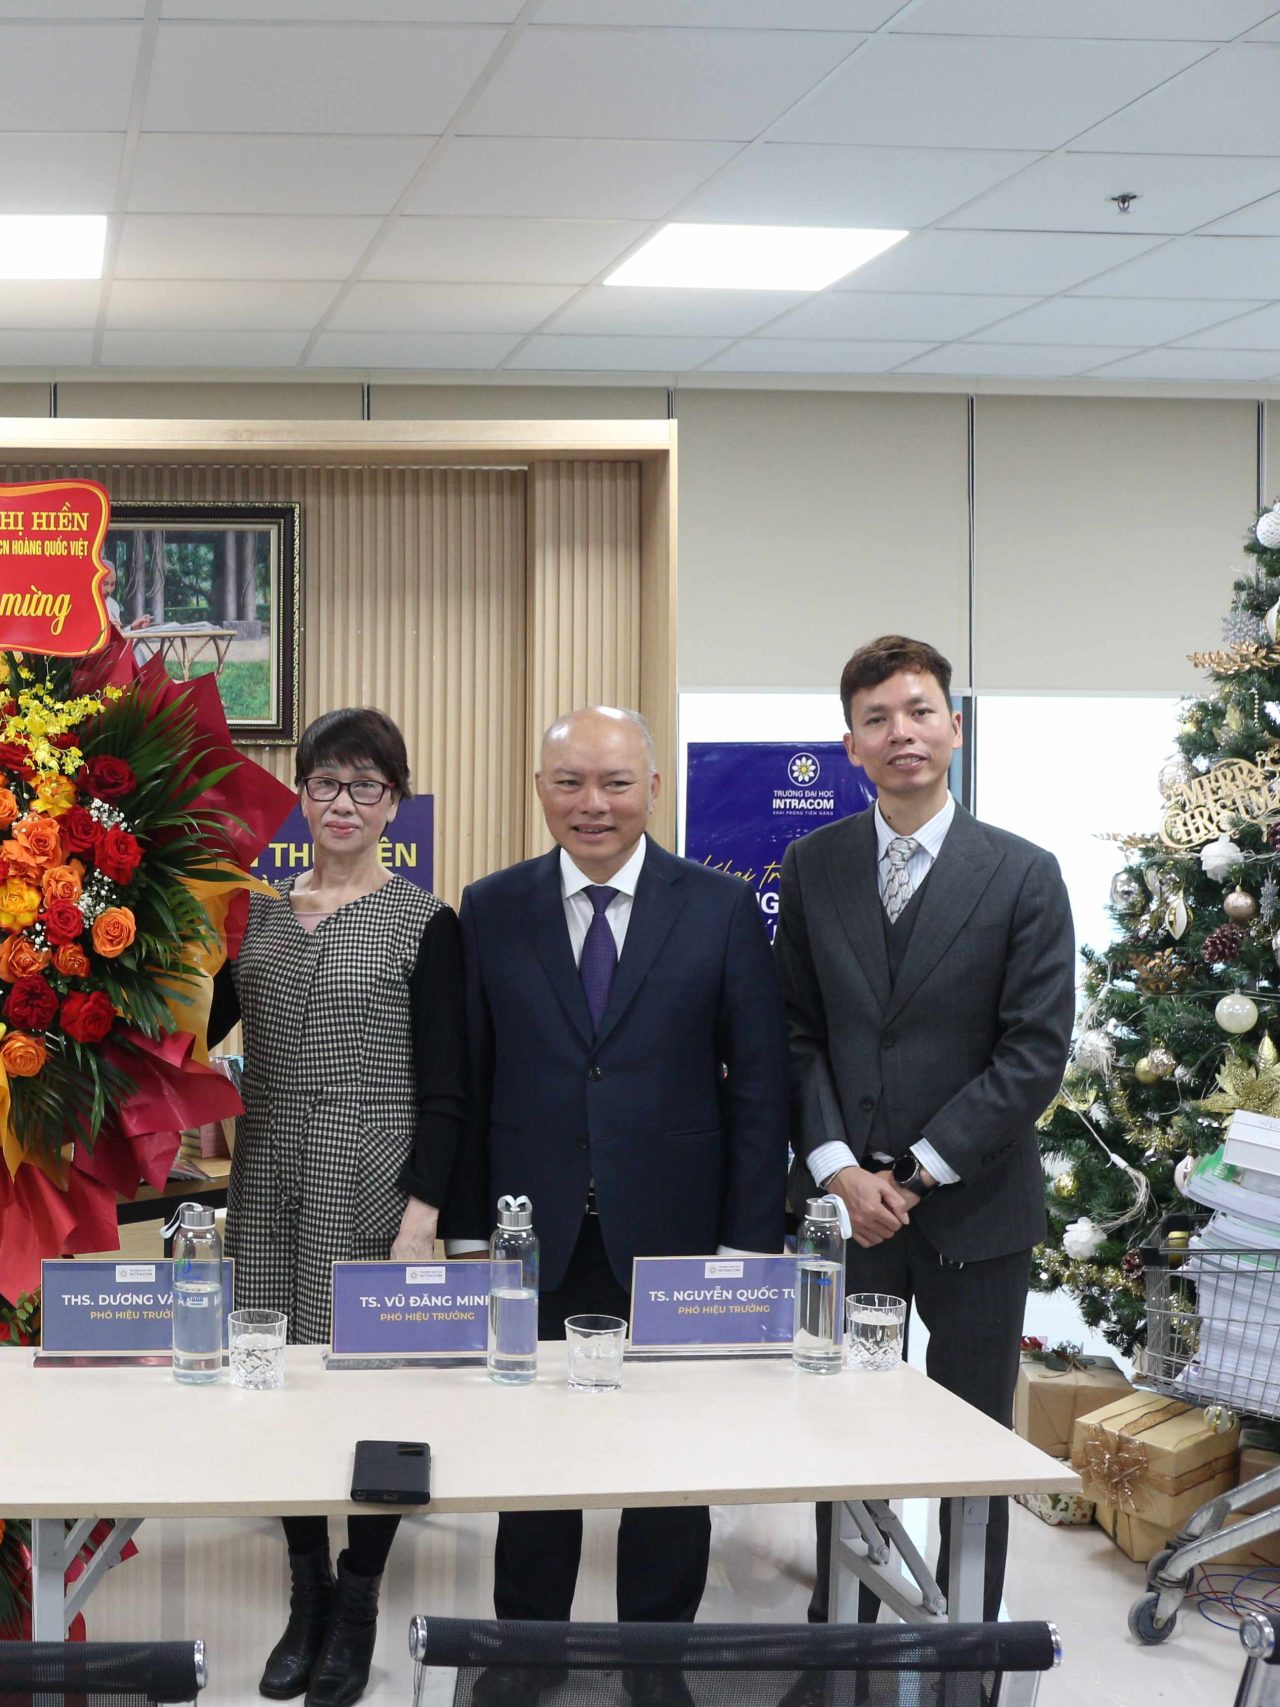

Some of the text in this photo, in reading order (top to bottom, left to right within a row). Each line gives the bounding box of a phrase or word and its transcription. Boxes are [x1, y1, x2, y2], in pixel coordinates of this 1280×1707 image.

[31, 501, 89, 532] HIỀN
[12, 536, 42, 556] HOÀNG
[44, 535, 67, 557] QUỐC
[70, 537, 88, 559] VIỆT
[772, 798, 834, 809] INTRACOM
[62, 1295, 95, 1306] THS.
[98, 1293, 154, 1306] DƯƠNG
[649, 1291, 669, 1301] TS.
[673, 1286, 732, 1300] NGUYỄN
[736, 1286, 778, 1301] QUỐC
[360, 1297, 381, 1308] TS.
[385, 1293, 406, 1308] VŨ
[409, 1294, 452, 1307] ĐĂNG
[90, 1309, 112, 1320] PHÓ
[115, 1310, 140, 1321] HIỆU
[380, 1311, 402, 1321] PHÓ
[405, 1311, 429, 1322] HIỆU
[678, 1305, 699, 1315] PHÓ
